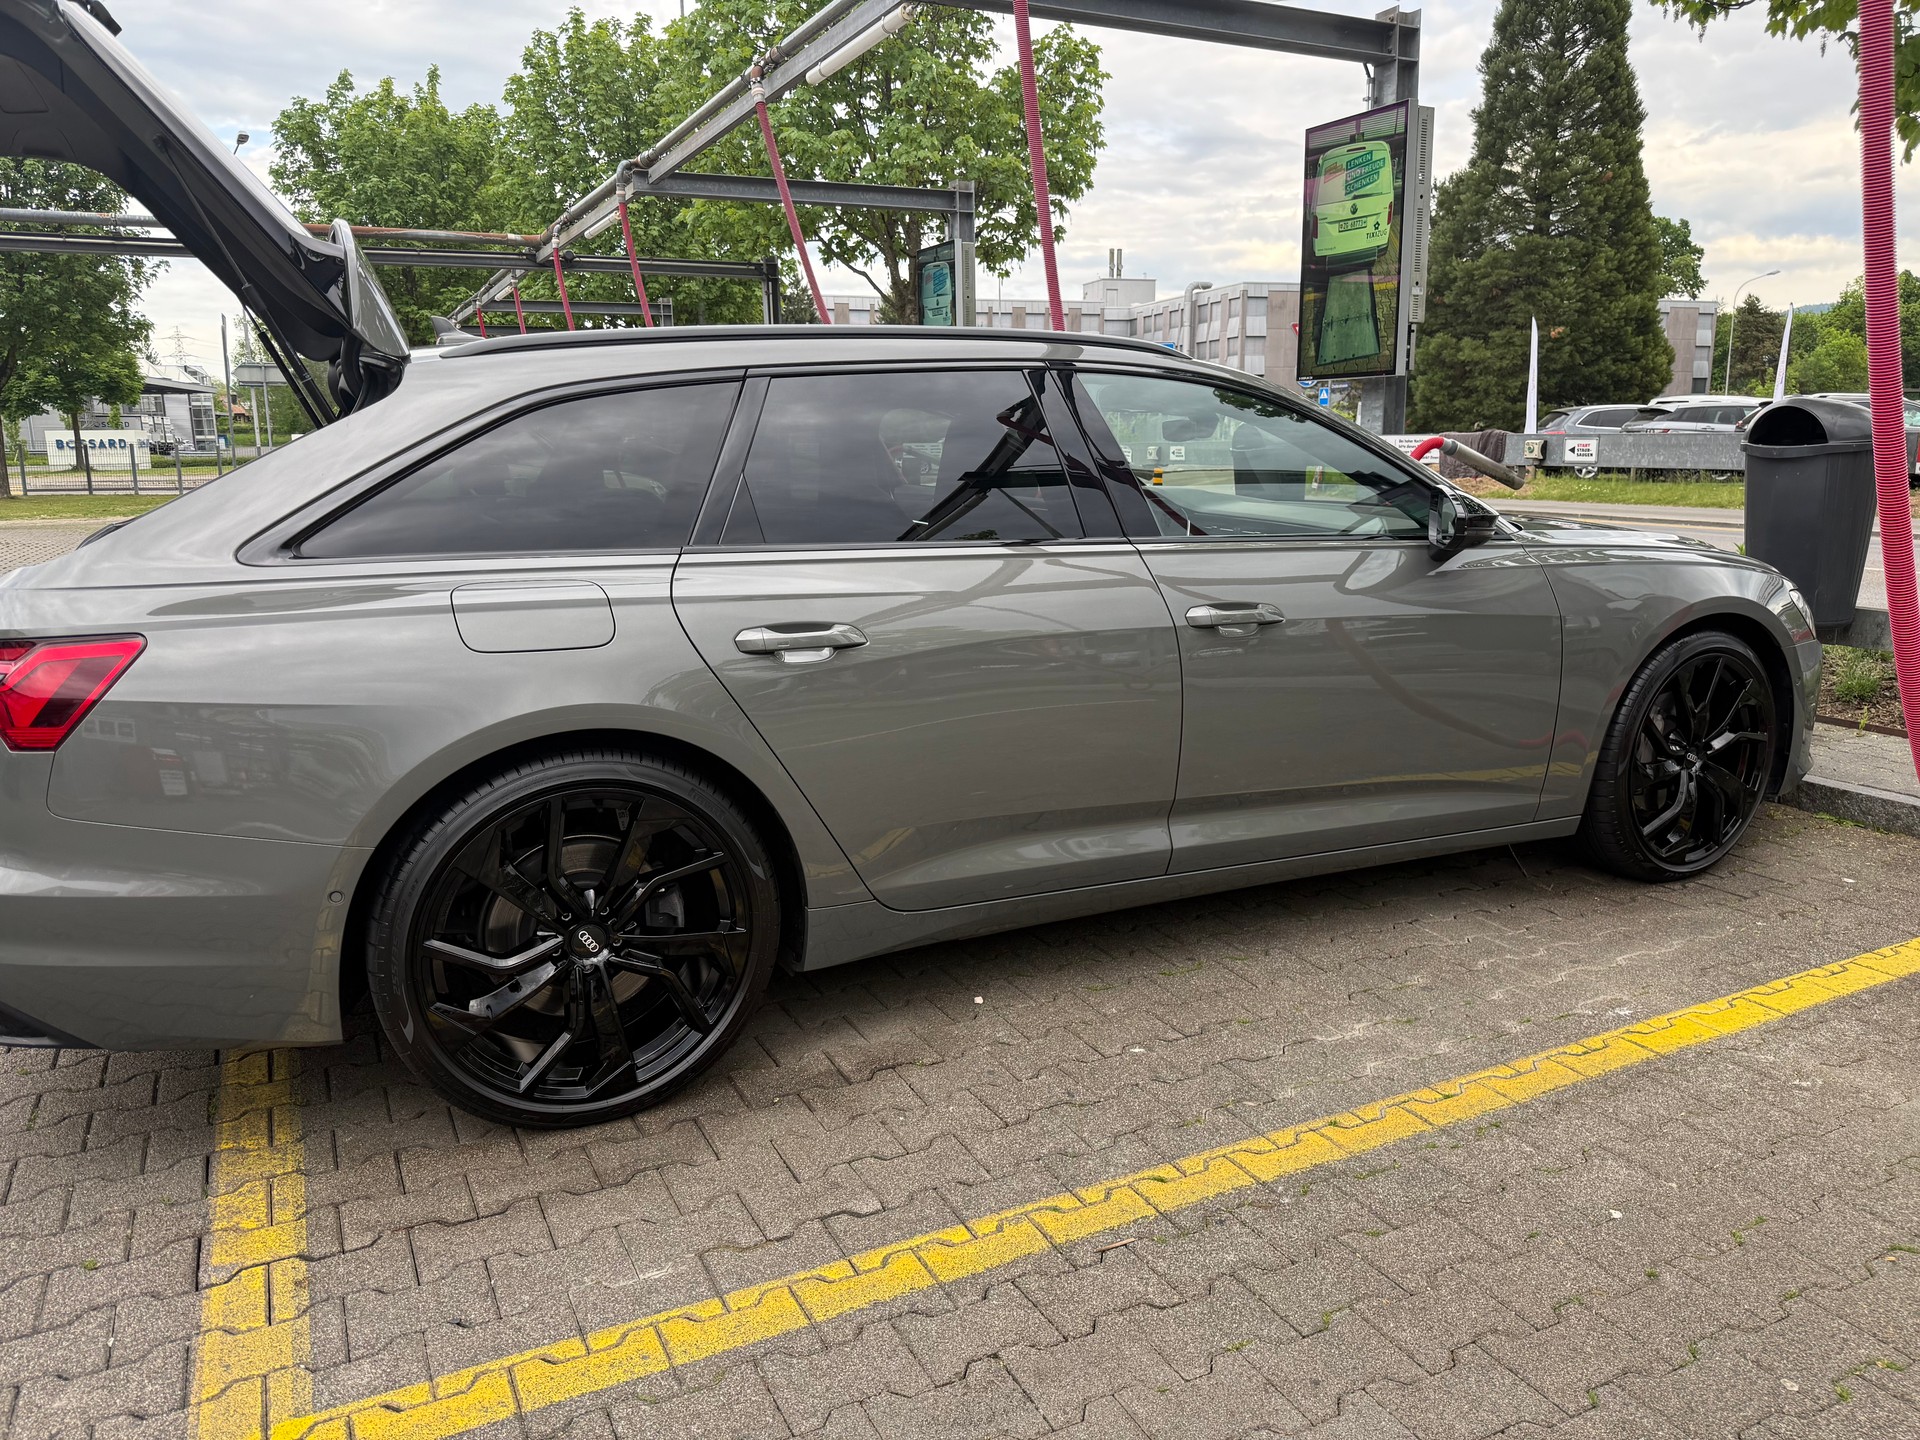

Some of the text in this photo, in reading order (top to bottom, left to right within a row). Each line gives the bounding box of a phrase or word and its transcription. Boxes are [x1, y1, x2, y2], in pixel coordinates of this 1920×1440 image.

[1347, 152, 1372, 169] LENKEN
[1361, 159, 1385, 174] FREUDE
[1346, 173, 1378, 193] SCHENKEN
